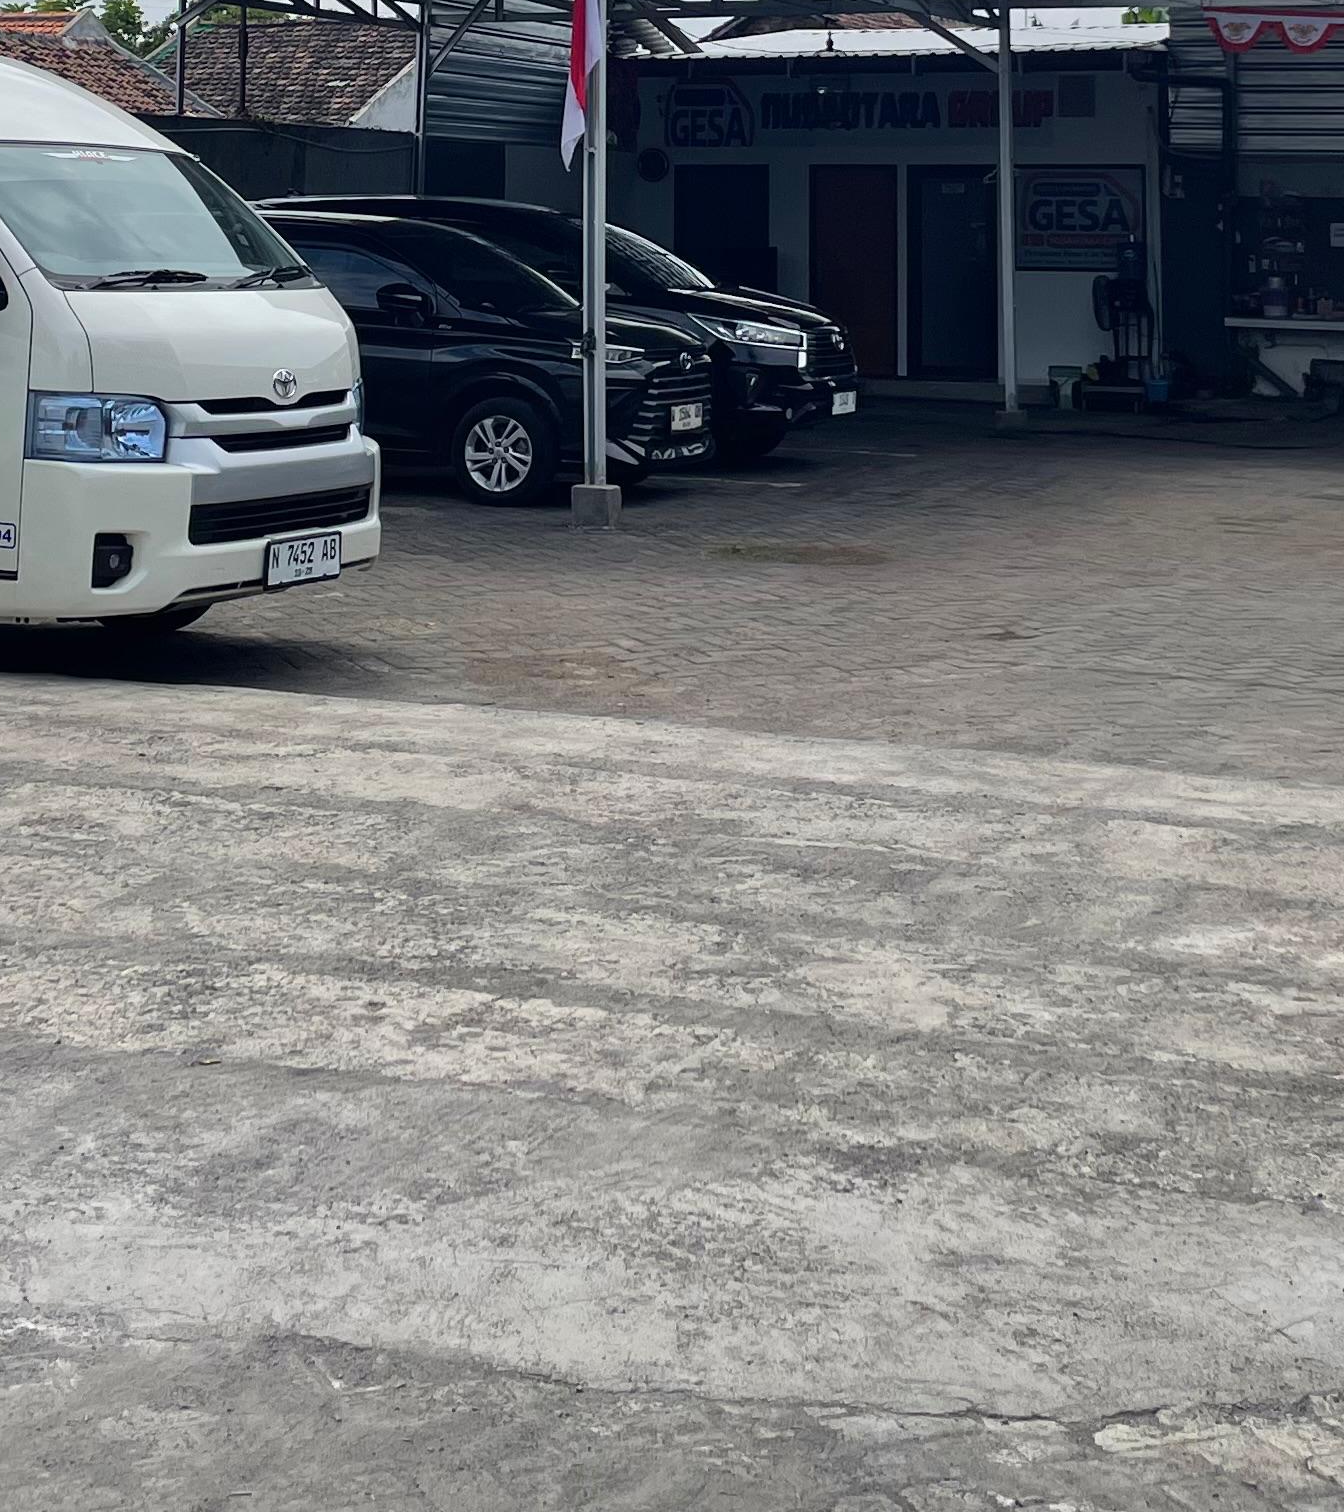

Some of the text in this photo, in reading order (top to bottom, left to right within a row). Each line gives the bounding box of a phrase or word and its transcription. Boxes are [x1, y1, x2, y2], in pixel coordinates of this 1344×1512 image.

[672, 105, 747, 147] GESA
[1029, 199, 1130, 232] GESA
[272, 538, 337, 569] N 7452 AB
